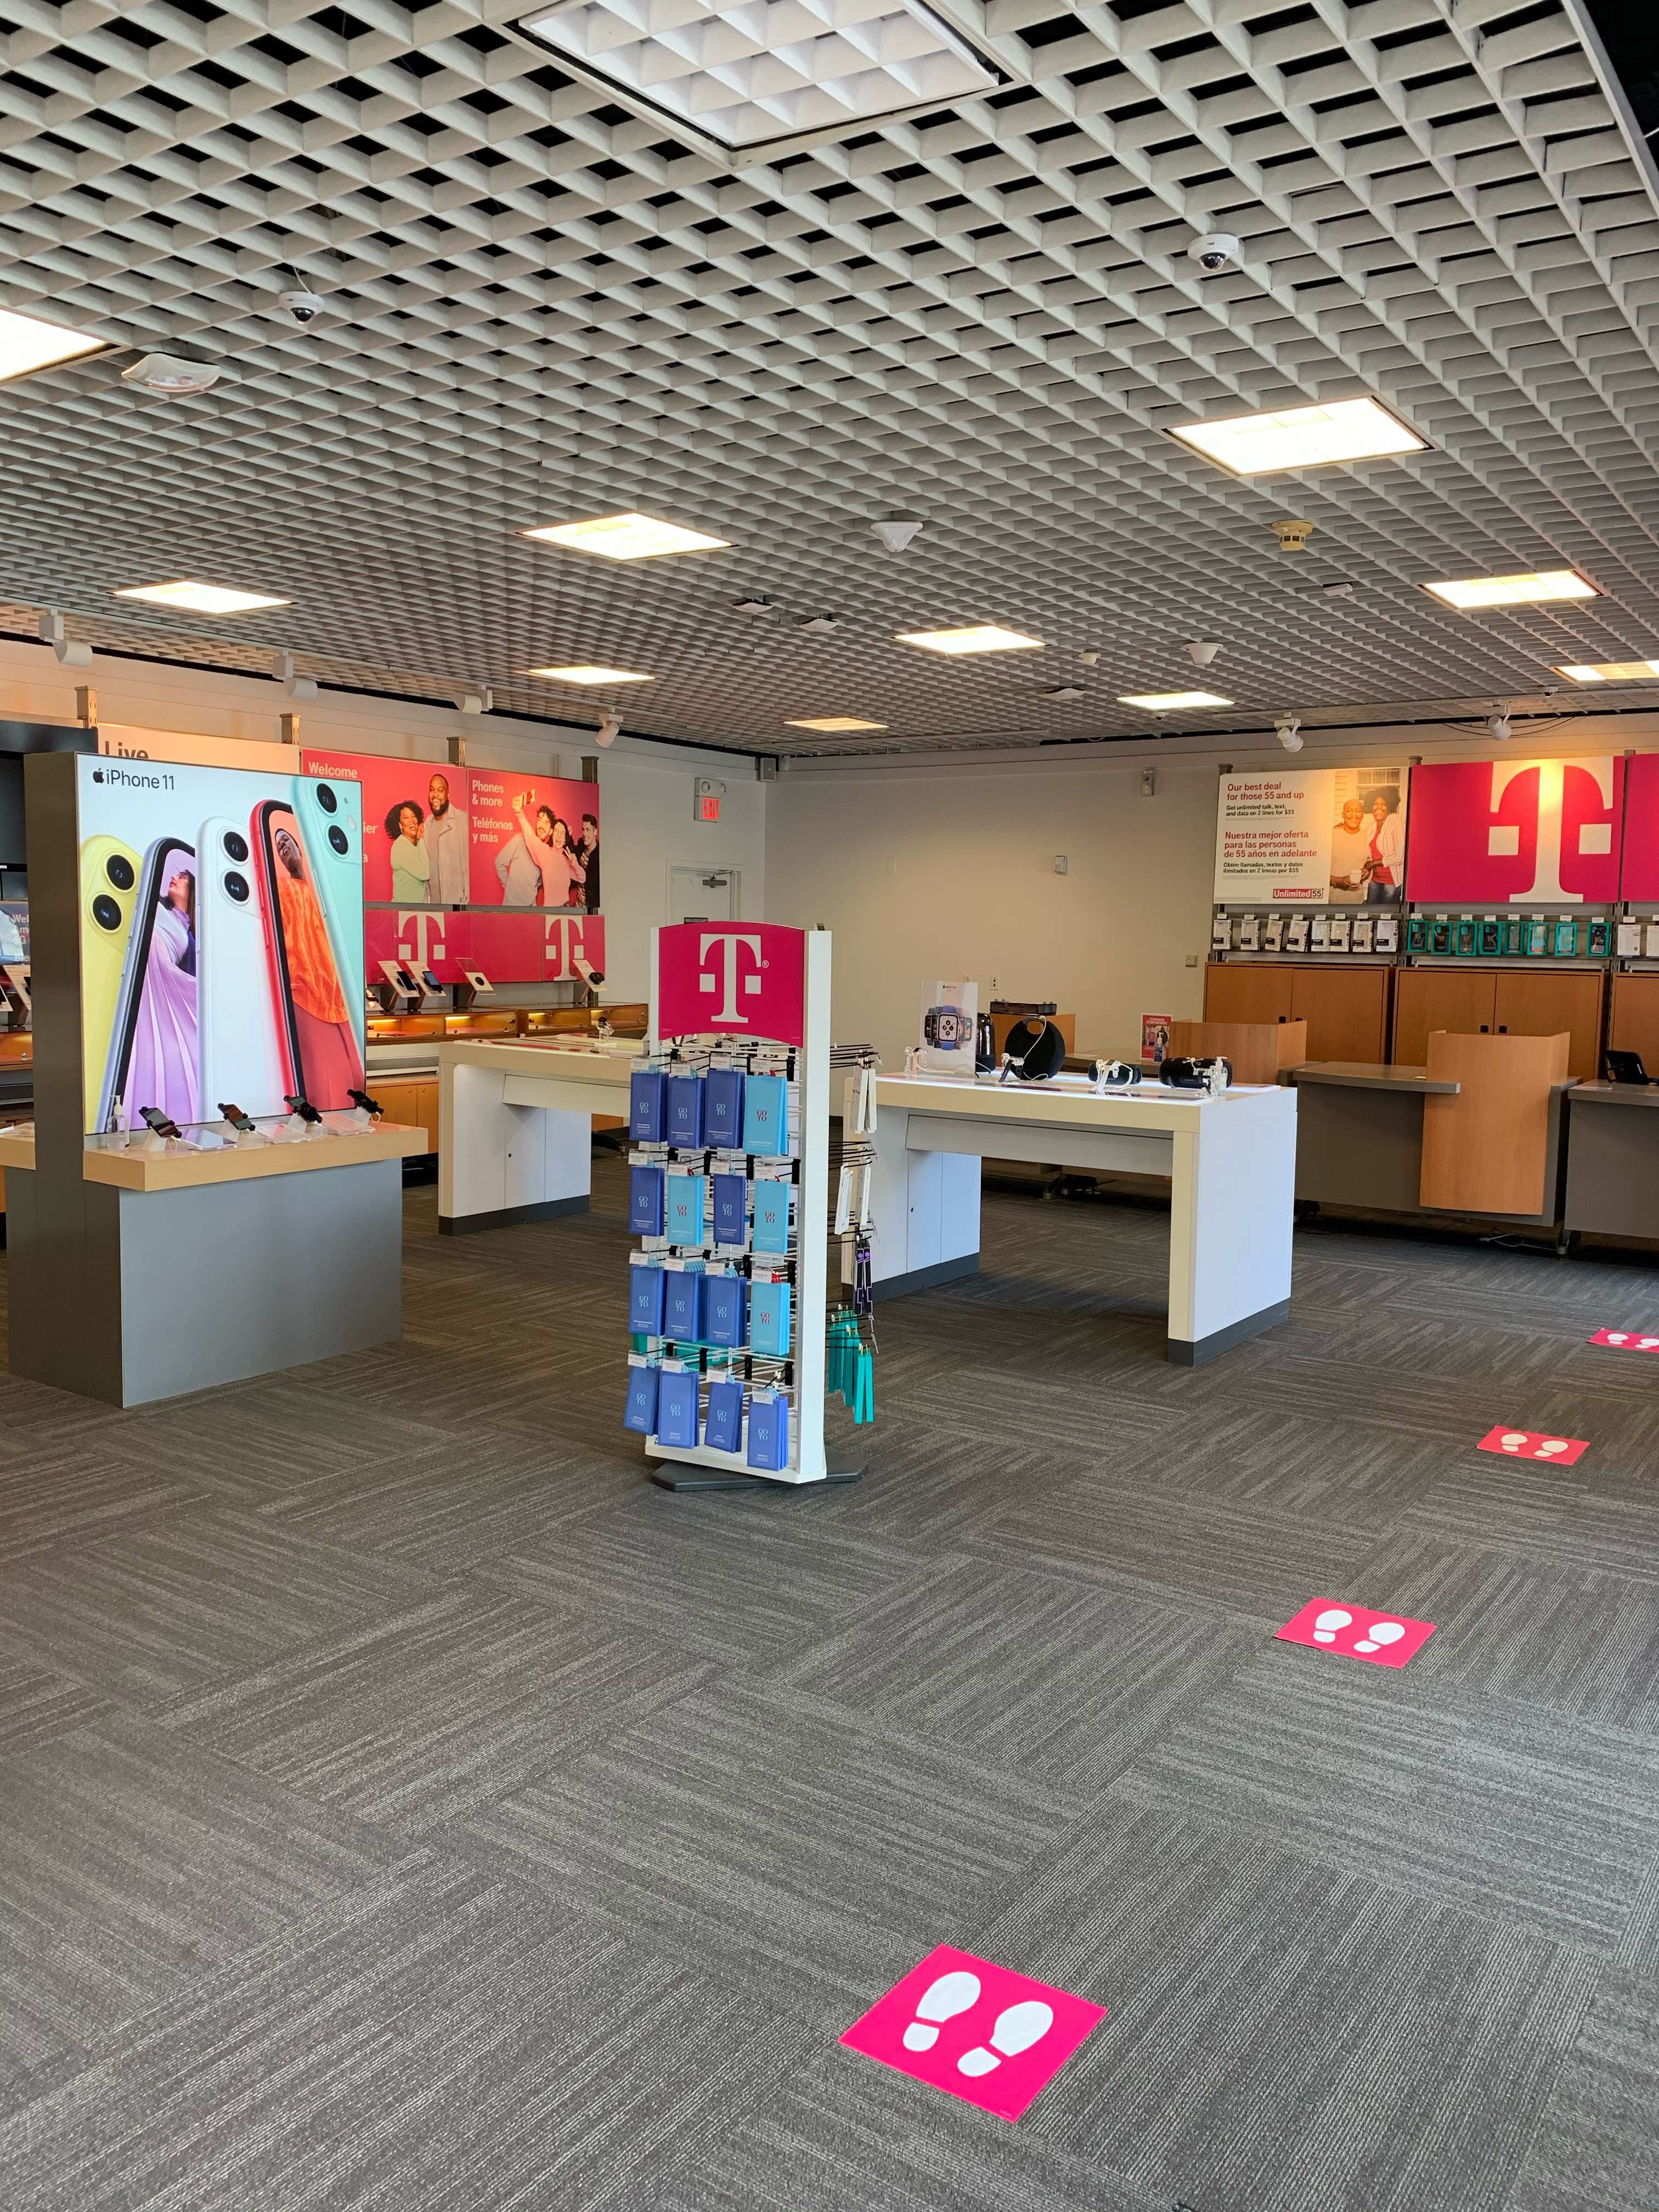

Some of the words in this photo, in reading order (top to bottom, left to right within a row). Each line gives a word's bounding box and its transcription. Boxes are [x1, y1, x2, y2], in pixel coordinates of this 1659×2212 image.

[308, 761, 358, 778] Welcome
[106, 769, 160, 789] iPhone
[162, 775, 174, 790] 11
[472, 779, 505, 793] Phones
[1264, 782, 1281, 790] deal
[472, 793, 478, 805] &
[480, 797, 503, 807] more
[1265, 791, 1274, 799] 55
[703, 799, 720, 820] EXIT
[472, 816, 514, 831] Teléfonos
[472, 833, 478, 844] y
[480, 832, 499, 843] más
[1259, 831, 1282, 840] mejor
[1259, 841, 1297, 849] personas
[1274, 889, 1311, 898] Unlimited
